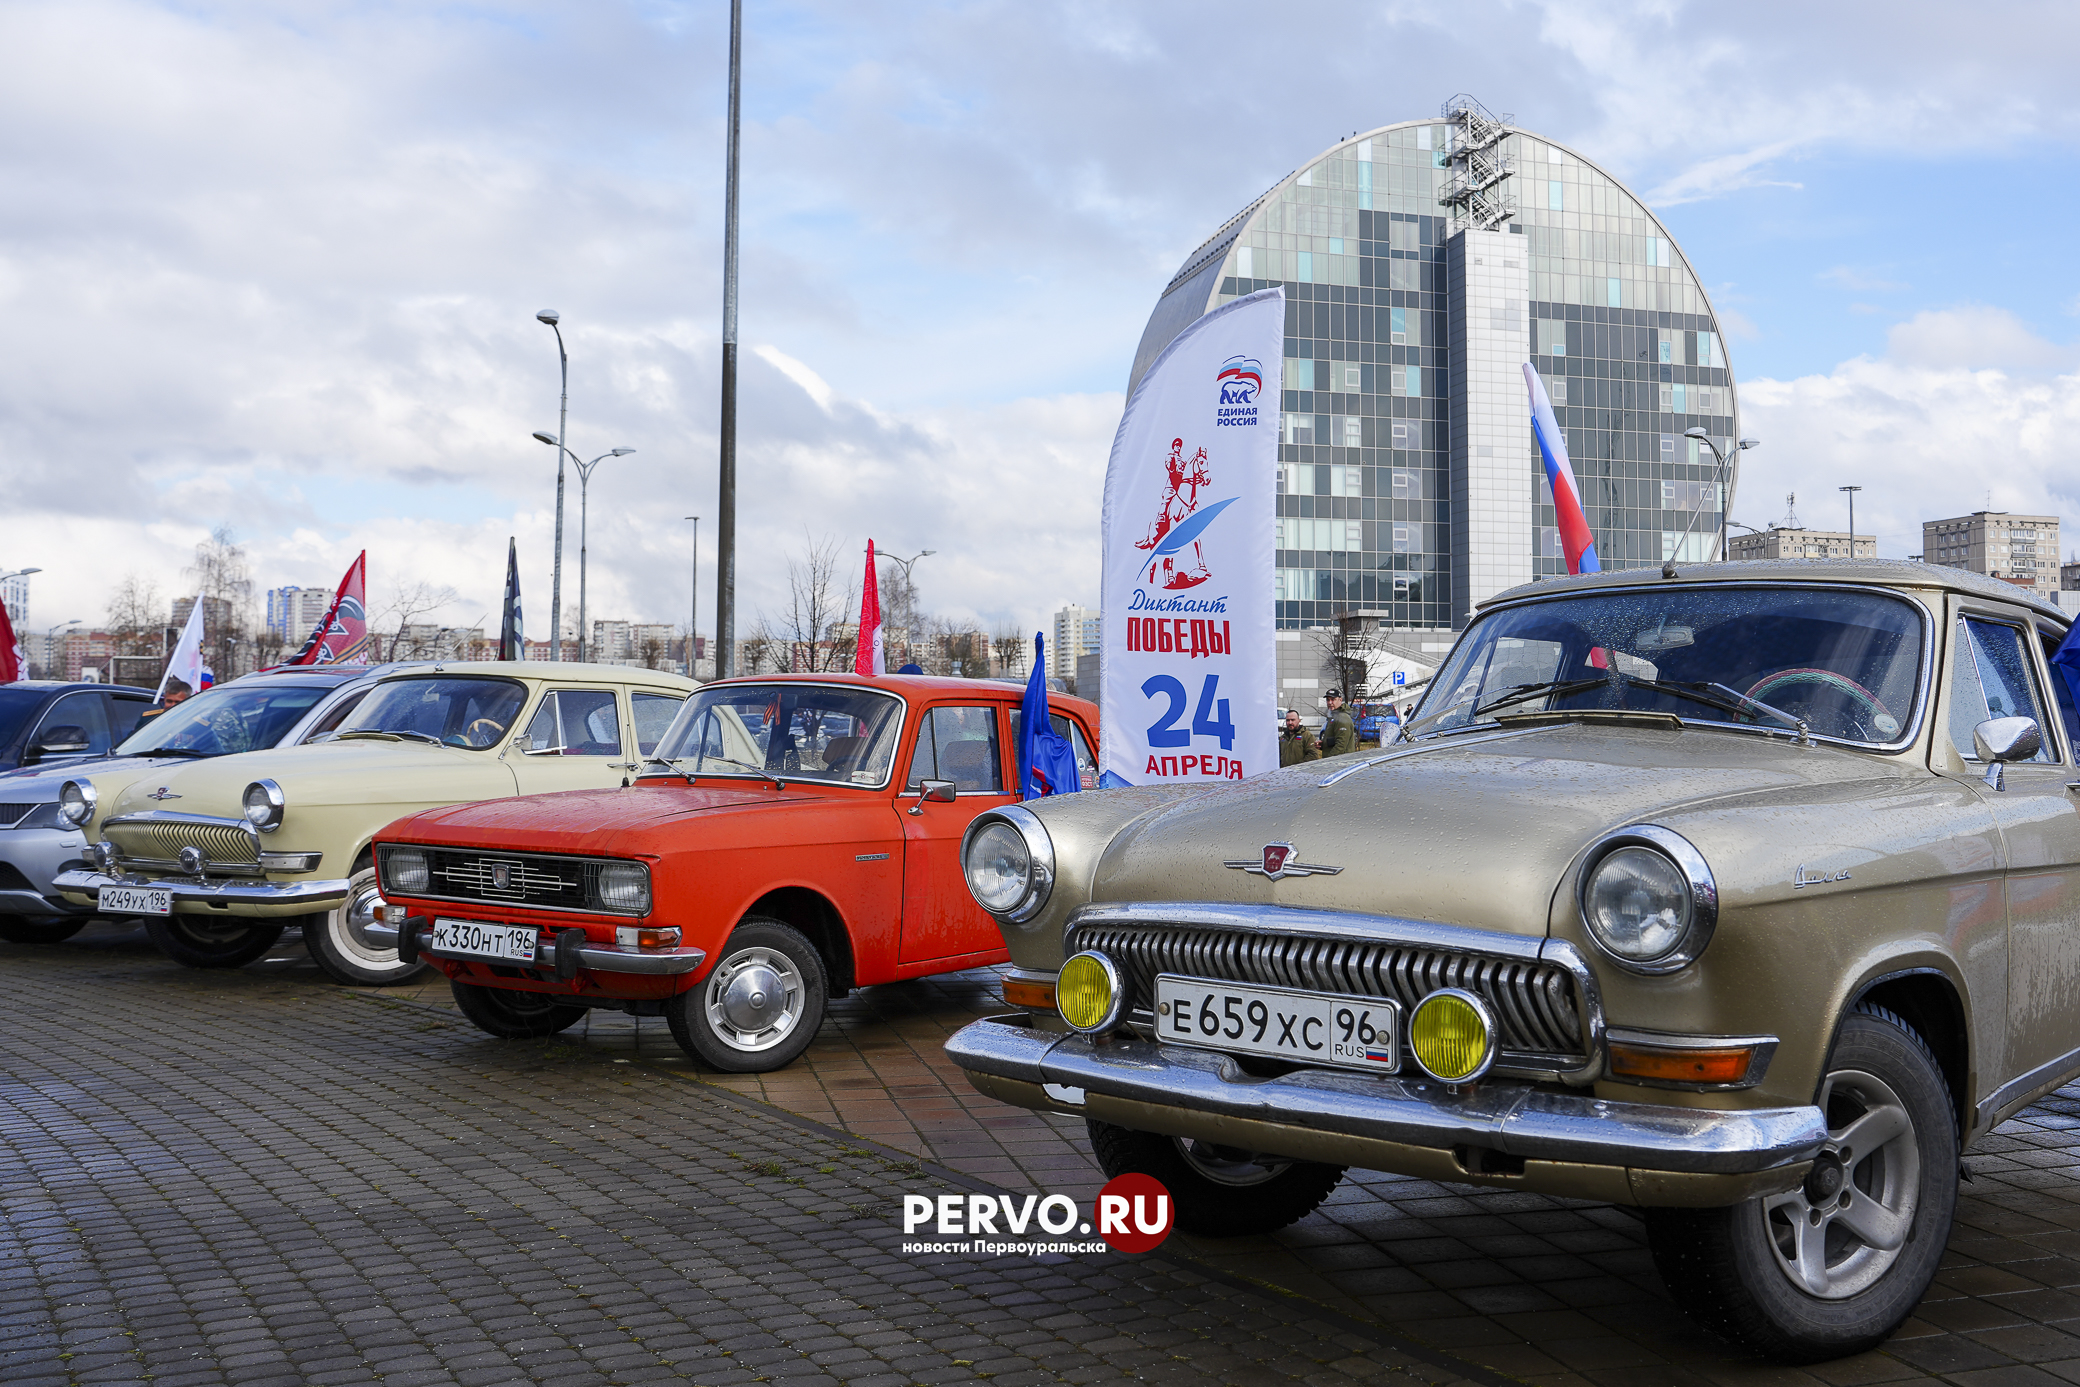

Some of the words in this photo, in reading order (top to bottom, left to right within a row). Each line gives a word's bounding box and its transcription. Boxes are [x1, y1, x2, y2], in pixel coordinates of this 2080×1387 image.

[1217, 407, 1258, 417] ЕДИНАЯ
[1217, 417, 1257, 427] РОССИЯ
[1128, 588, 1228, 613] Диктант
[1127, 616, 1231, 659] ПОБЕДЫ
[1141, 674, 1235, 751] 24
[1145, 754, 1243, 780] АПРЕЛЯ
[149, 892, 166, 906] 196
[508, 929, 534, 950] 196
[510, 949, 523, 957] RUS
[1336, 1008, 1376, 1045] 96
[1335, 1044, 1364, 1058] RUS
